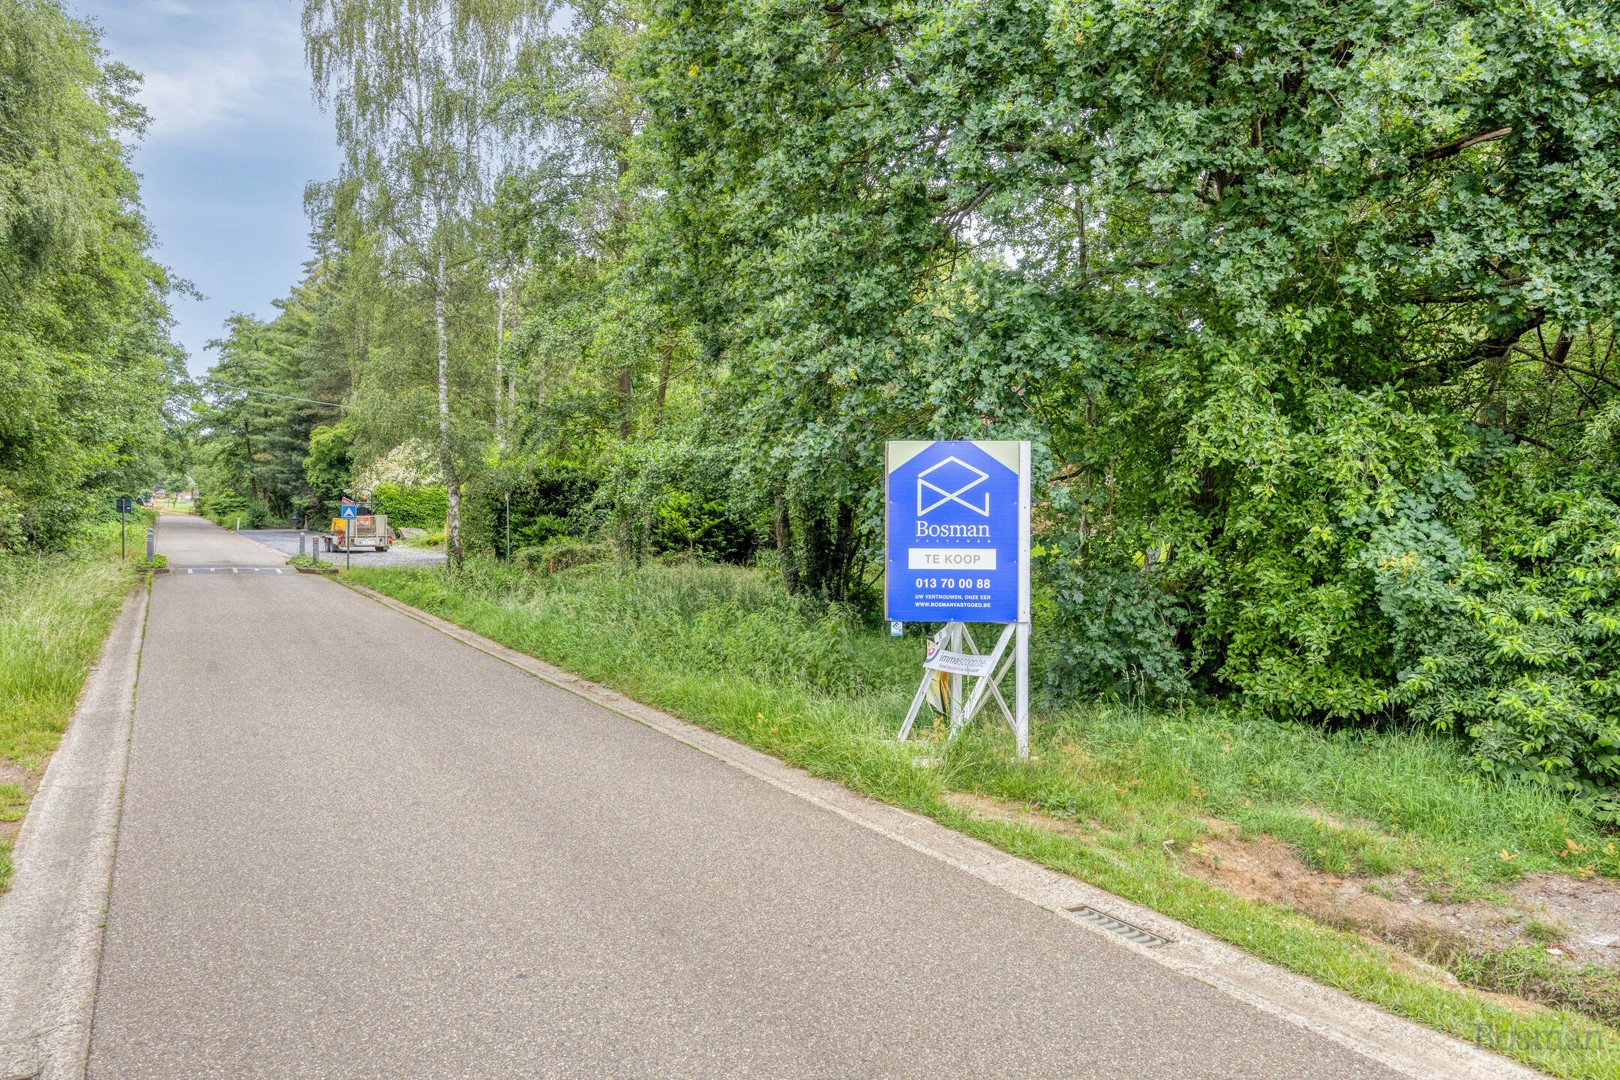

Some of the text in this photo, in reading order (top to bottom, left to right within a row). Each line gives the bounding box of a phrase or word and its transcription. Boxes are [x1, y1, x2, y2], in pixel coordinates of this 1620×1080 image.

[916, 520, 991, 537] Bosman
[924, 554, 981, 564] TE KOOP
[916, 578, 991, 589] 013 70 00 88
